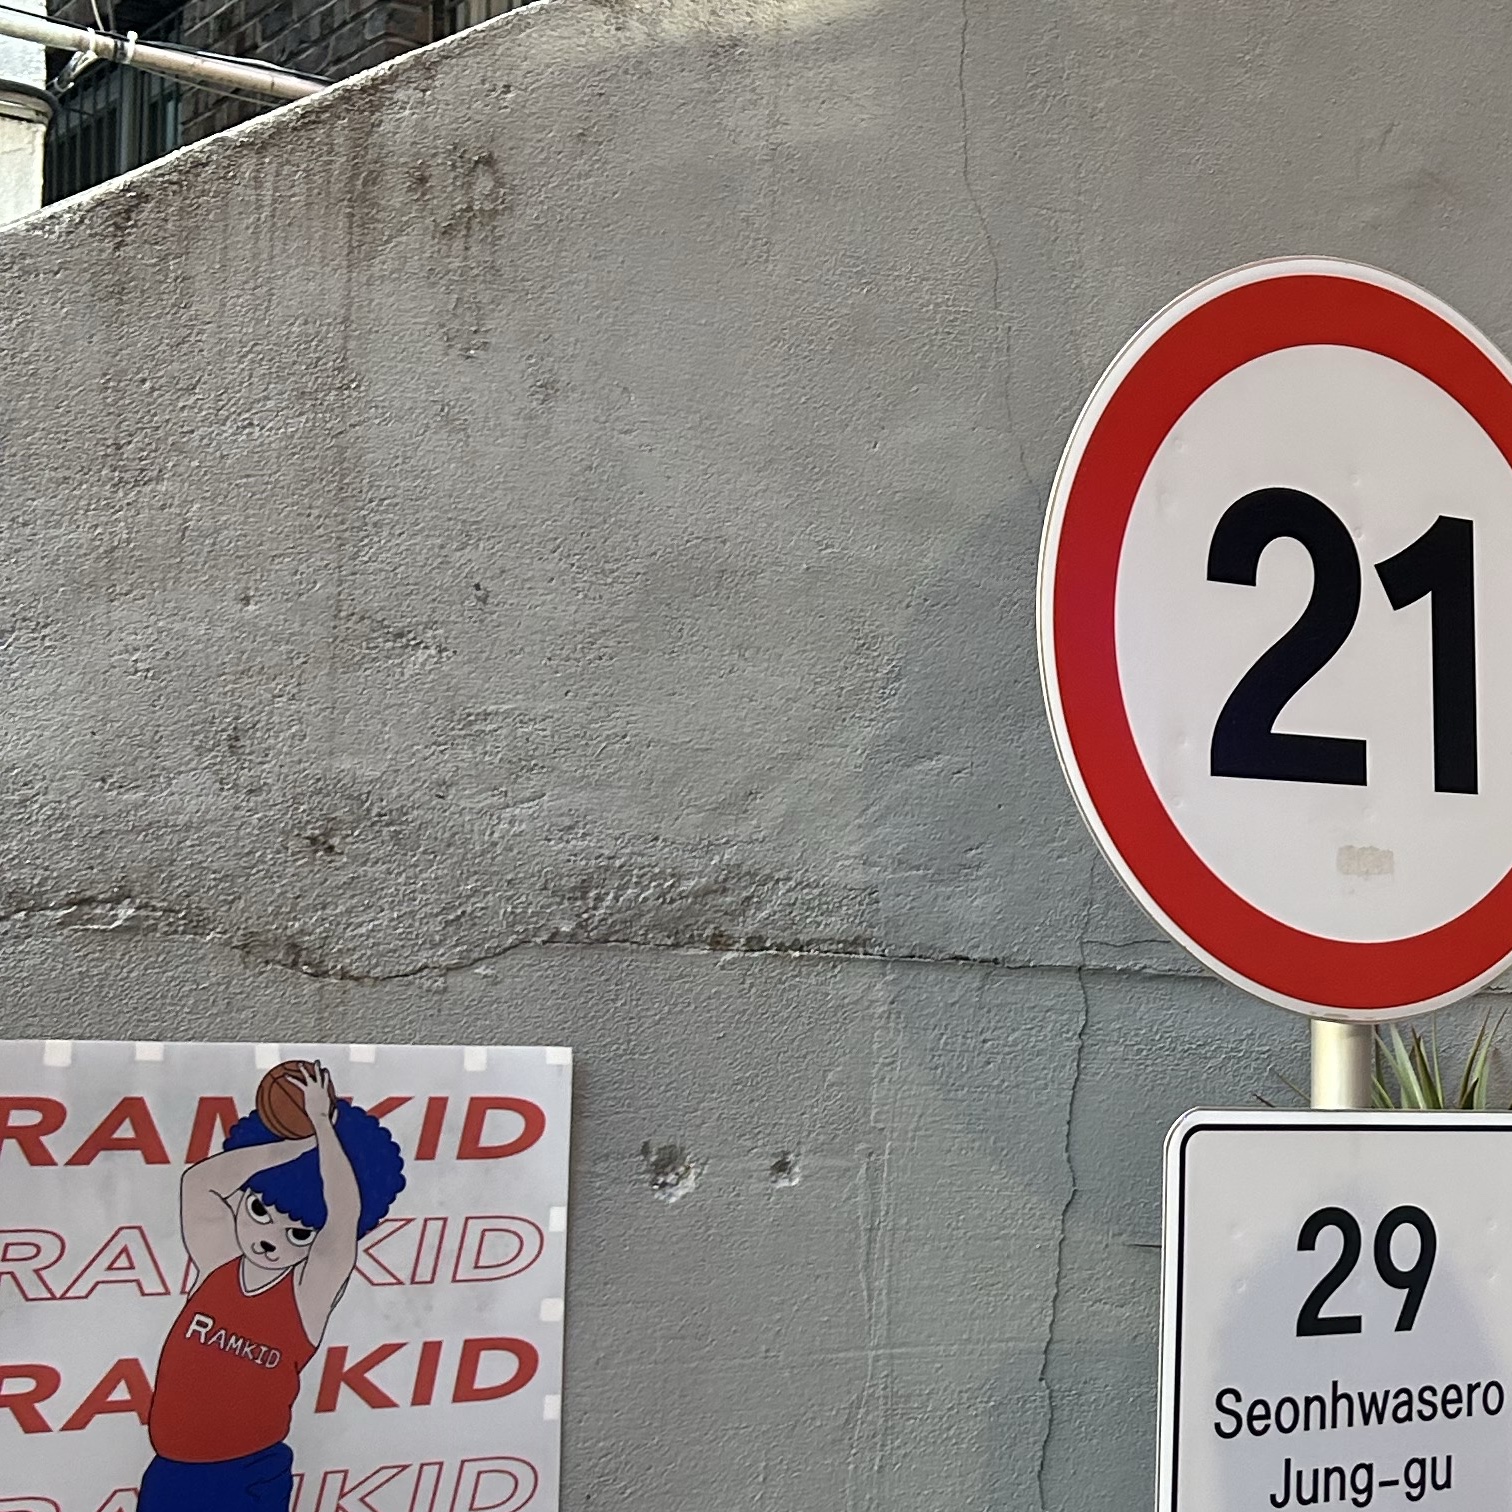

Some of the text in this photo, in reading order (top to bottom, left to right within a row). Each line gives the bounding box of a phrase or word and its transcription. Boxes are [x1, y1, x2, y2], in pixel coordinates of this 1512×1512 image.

[1207, 487, 1478, 795] 21
[0, 1216, 545, 1301] RAKID
[1296, 1205, 1437, 1337] 29
[185, 1312, 281, 1369] RAMKID
[0, 1337, 540, 1434] RAKID
[1214, 1379, 1505, 1439] Seonhwasero
[1270, 1454, 1453, 1510] Jung-gu
